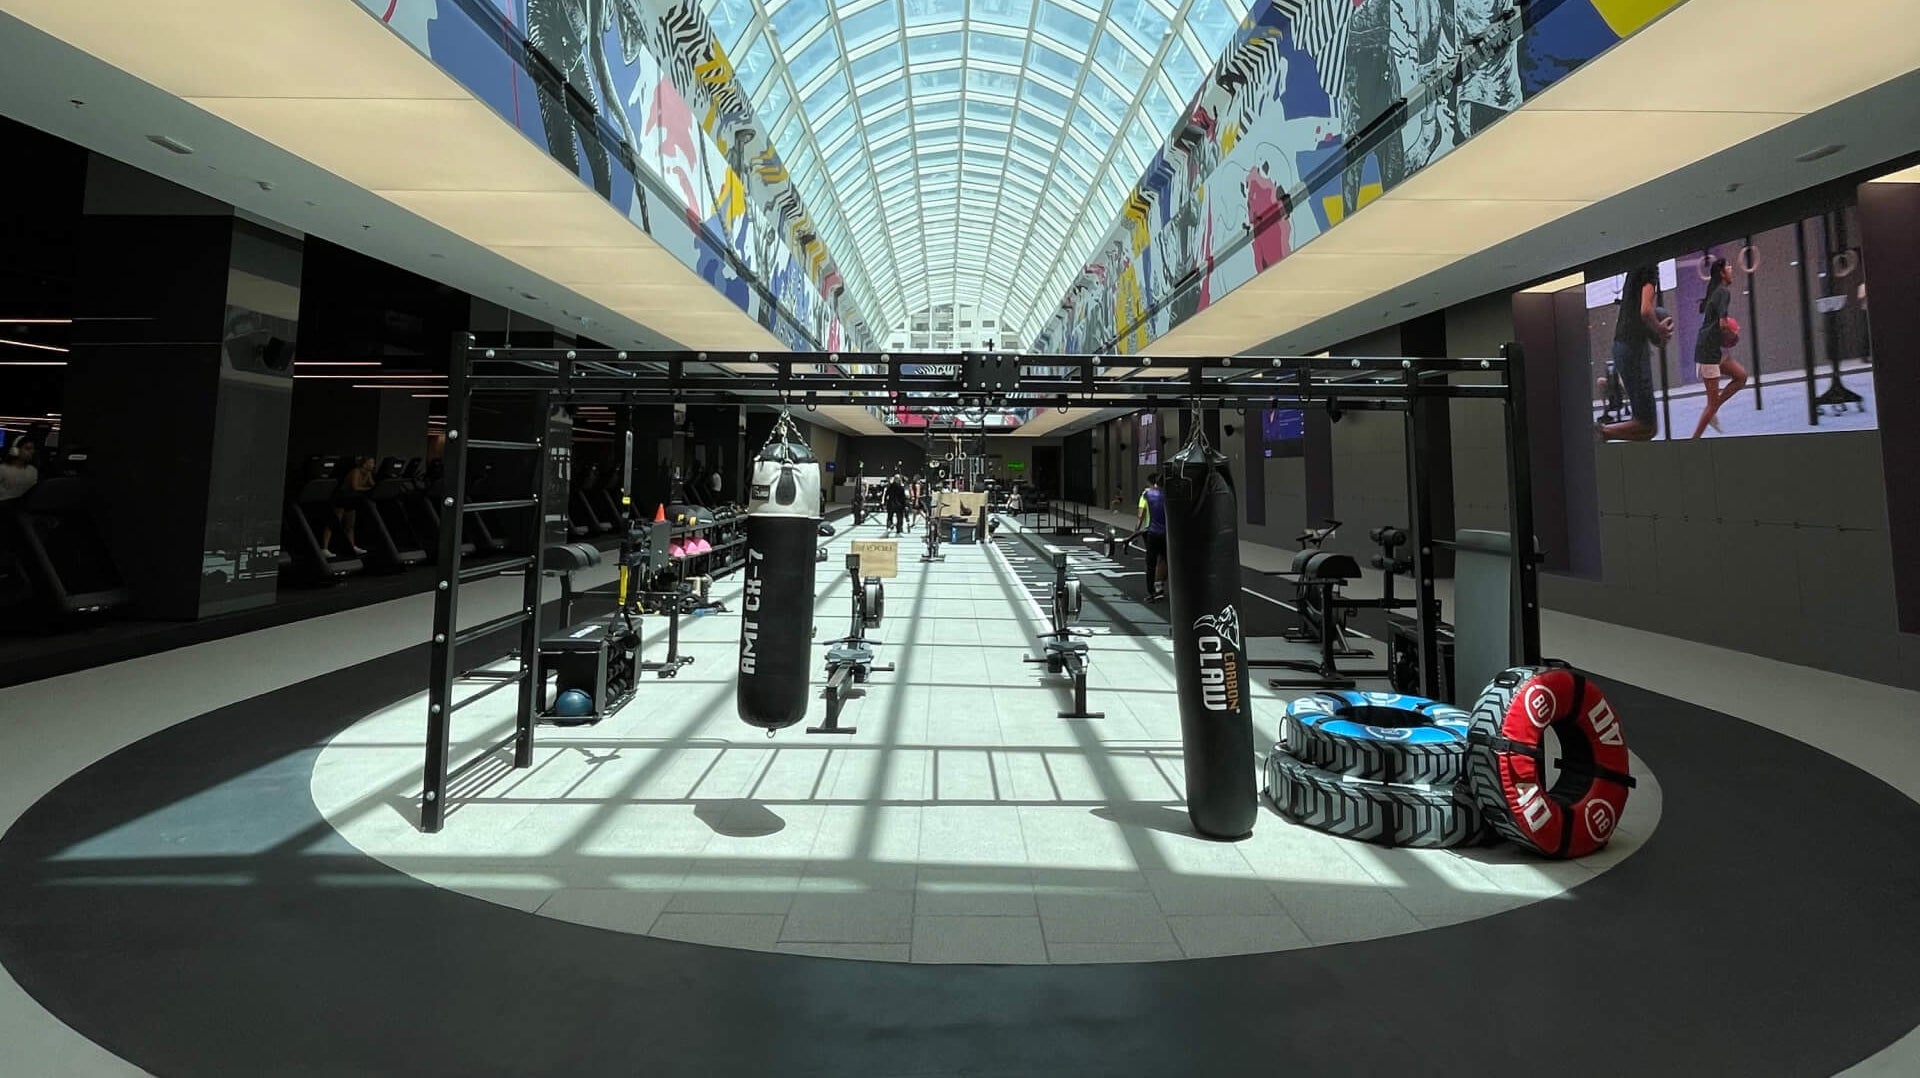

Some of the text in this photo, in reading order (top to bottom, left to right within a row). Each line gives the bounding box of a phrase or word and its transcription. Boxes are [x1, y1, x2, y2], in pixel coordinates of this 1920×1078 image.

[741, 617, 759, 675] AMT
[1198, 636, 1227, 711] CLAW
[1225, 652, 1239, 711] CARBON
